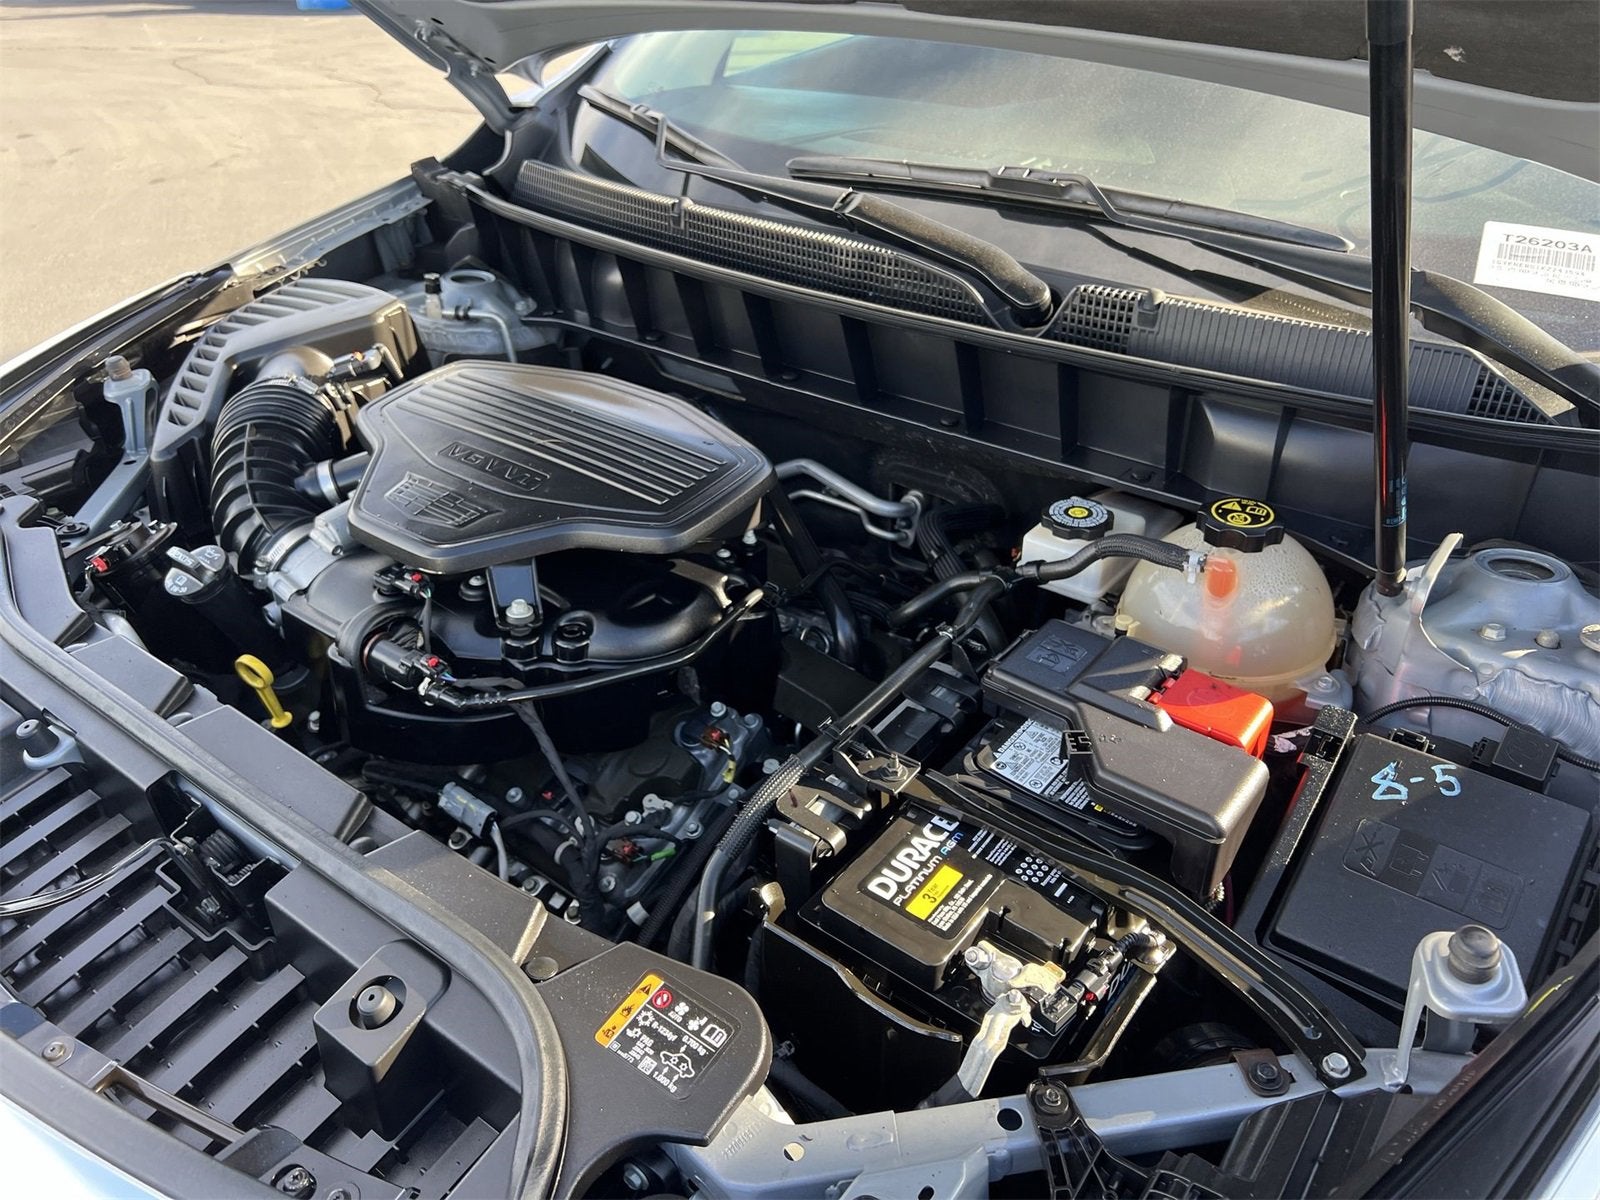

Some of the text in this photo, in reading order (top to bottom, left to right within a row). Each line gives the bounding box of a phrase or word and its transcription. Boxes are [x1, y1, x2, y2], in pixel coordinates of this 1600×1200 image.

[1503, 233, 1593, 253] T26203A
[893, 855, 943, 907] PLATINUM
[940, 832, 964, 856] AGM
[922, 892, 937, 904] 3
